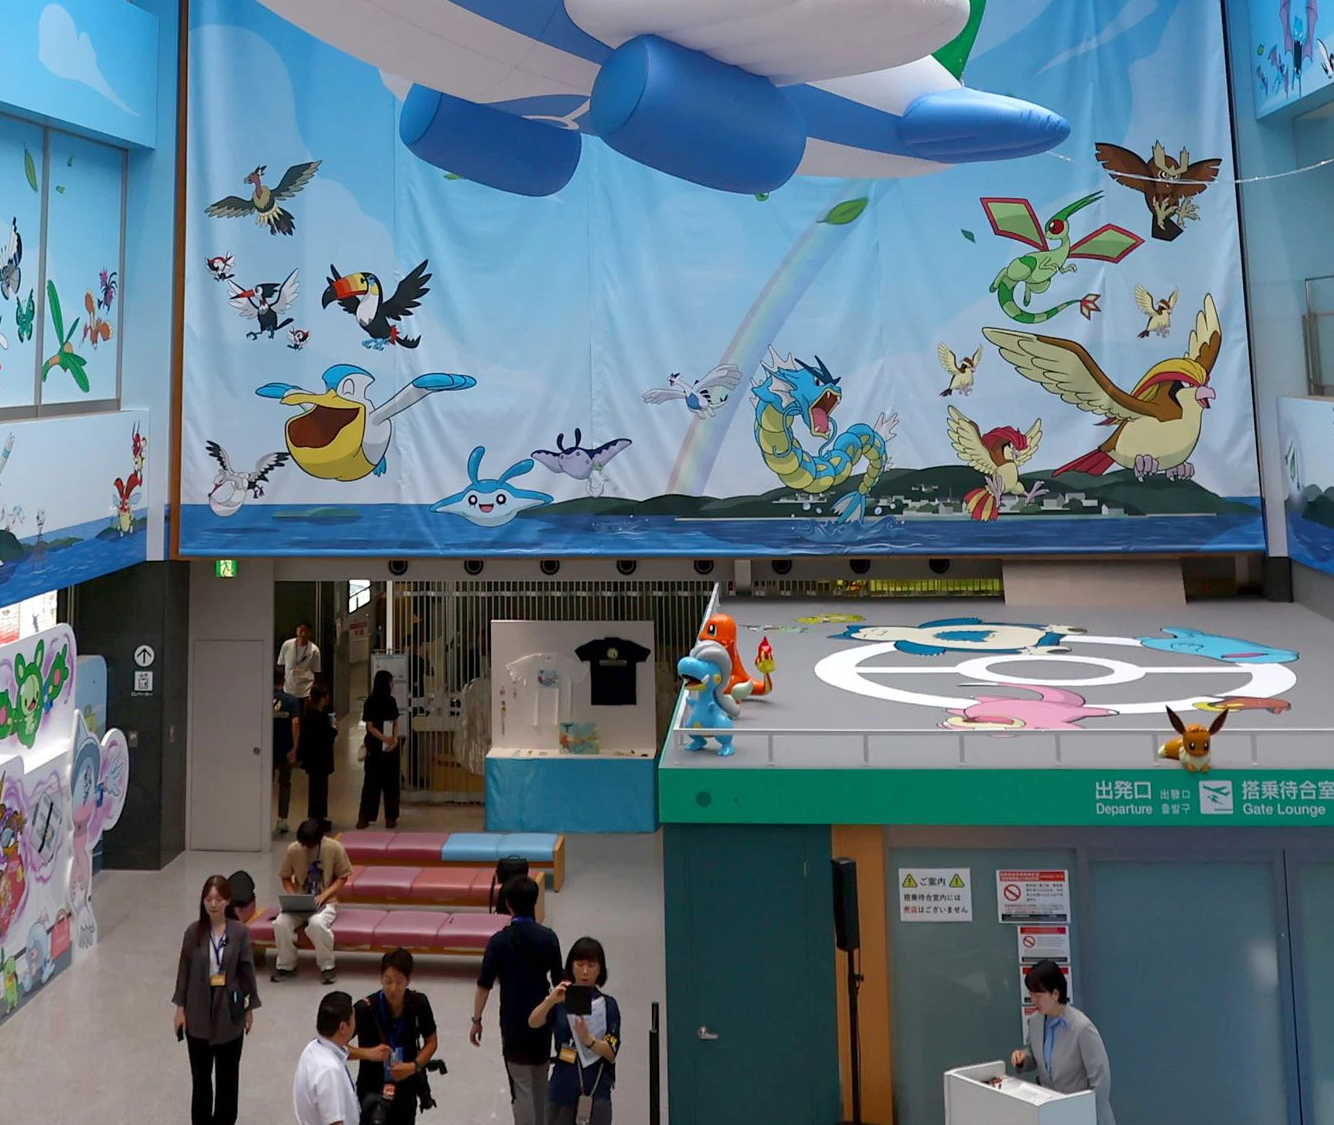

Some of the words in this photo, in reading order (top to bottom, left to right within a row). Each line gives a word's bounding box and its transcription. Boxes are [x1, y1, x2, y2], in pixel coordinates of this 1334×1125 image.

[1095, 780, 1152, 800] 出発口
[1096, 803, 1153, 816] Departure
[1243, 802, 1275, 815] Gate
[1278, 802, 1326, 818] Lounge
[920, 877, 946, 886] ご案内
[904, 893, 961, 902] 搭乗待合室内には
[903, 906, 969, 914] 売店はございません
